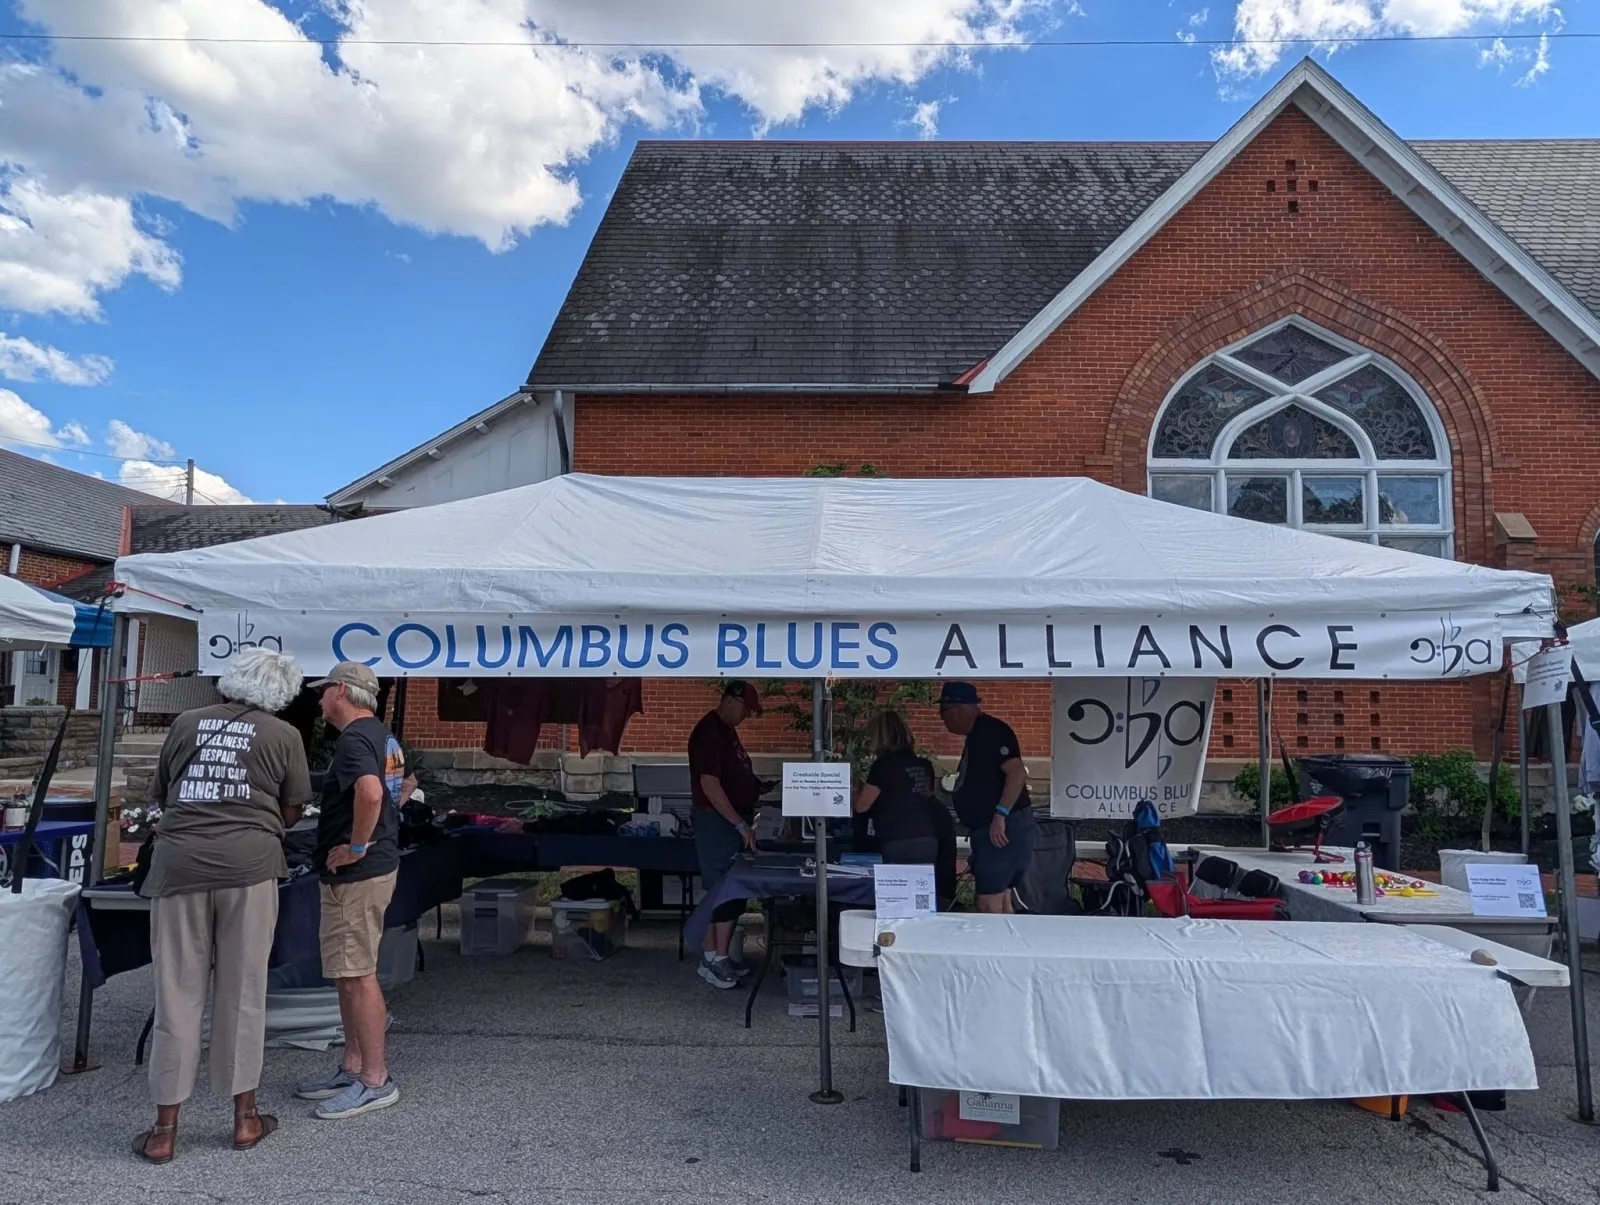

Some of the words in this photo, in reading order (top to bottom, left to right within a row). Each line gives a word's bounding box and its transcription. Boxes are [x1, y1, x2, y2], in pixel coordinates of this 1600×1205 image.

[331, 622, 690, 669] COLUMBUS
[716, 622, 899, 670] BLUES
[934, 623, 1358, 671] ALLIANCE
[200, 748, 238, 766] DESPAIR,
[187, 764, 205, 778] AND
[208, 765, 226, 779] YOU
[227, 767, 247, 780] CAN
[179, 780, 221, 800] DANCE
[223, 784, 235, 797] TO
[237, 783, 251, 800] IT!
[1065, 784, 1158, 800] COLUMBUS
[1098, 802, 1176, 813] ALLICE
[966, 1097, 1013, 1110] Gahanna
